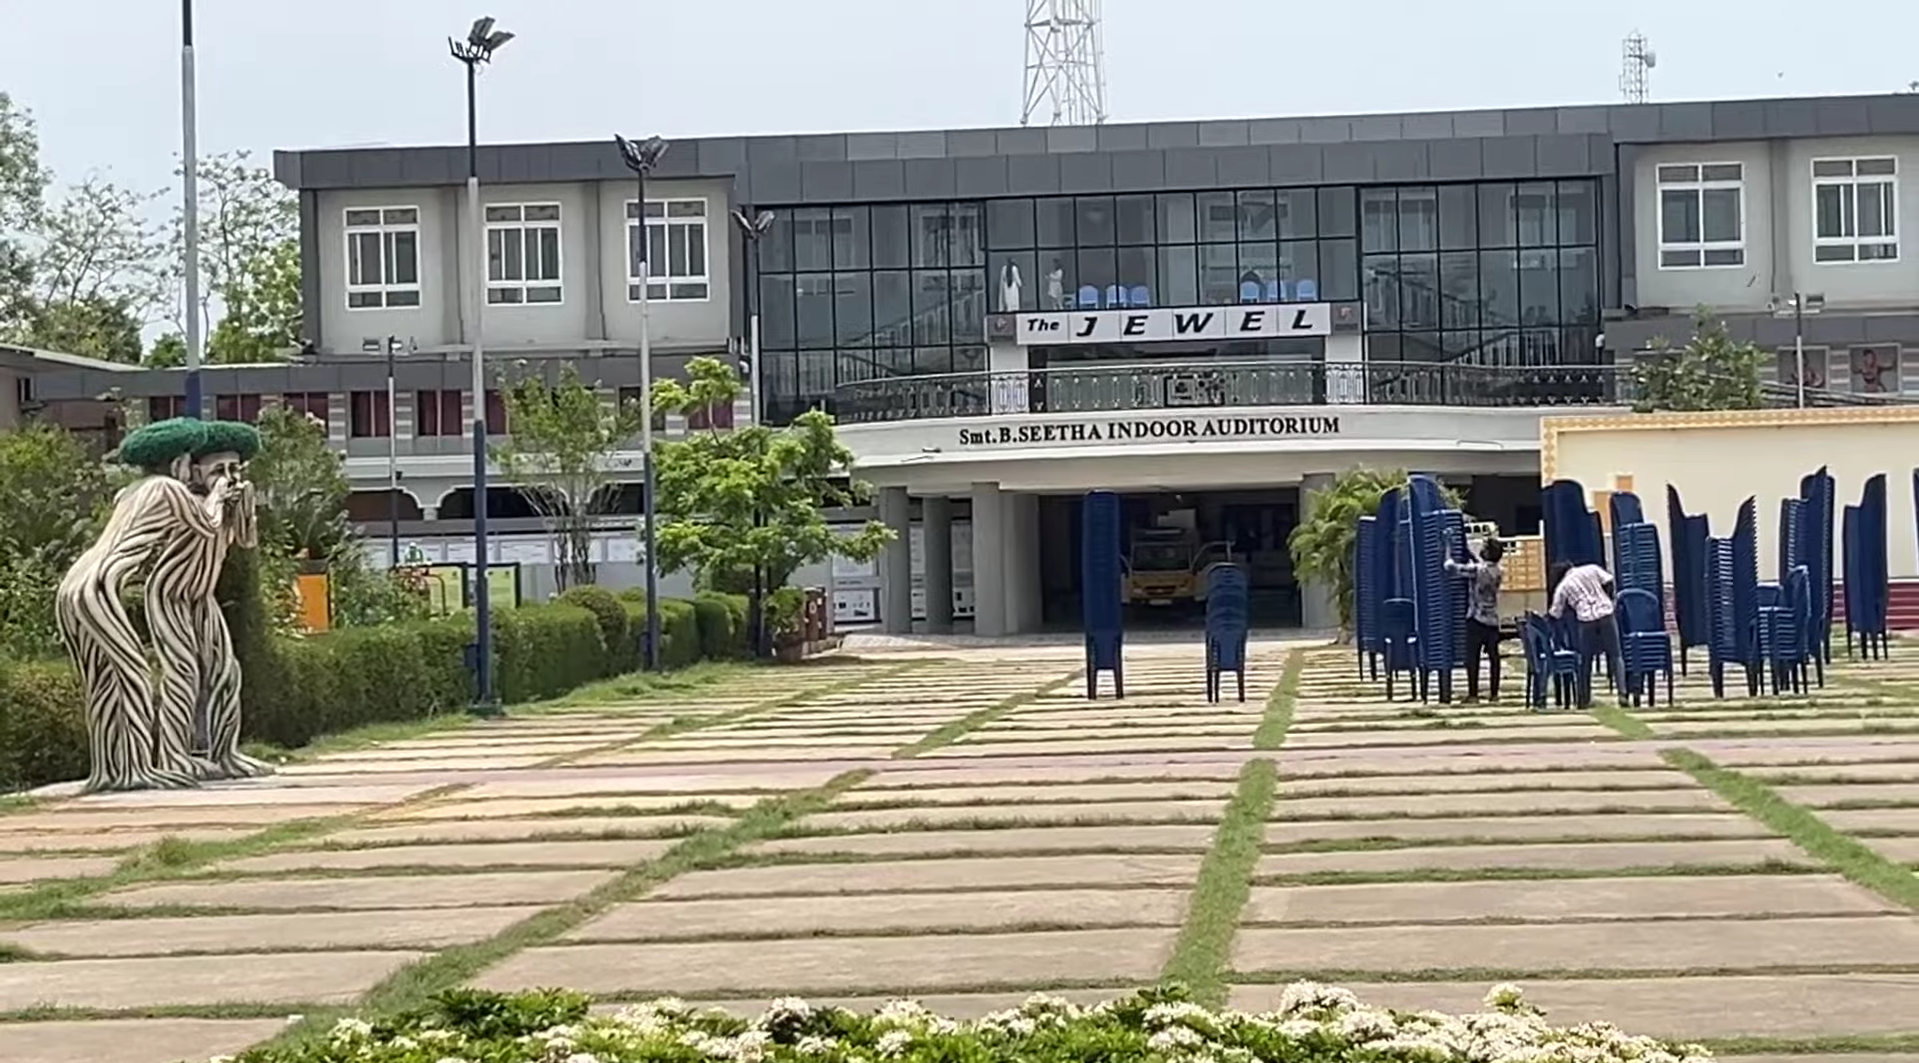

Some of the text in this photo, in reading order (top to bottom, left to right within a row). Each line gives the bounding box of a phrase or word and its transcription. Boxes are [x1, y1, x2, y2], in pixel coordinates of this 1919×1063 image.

[1027, 309, 1314, 337] The JEWEL
[1107, 419, 1198, 440] INDOOR
[1201, 416, 1340, 436] AUDITORIUM
